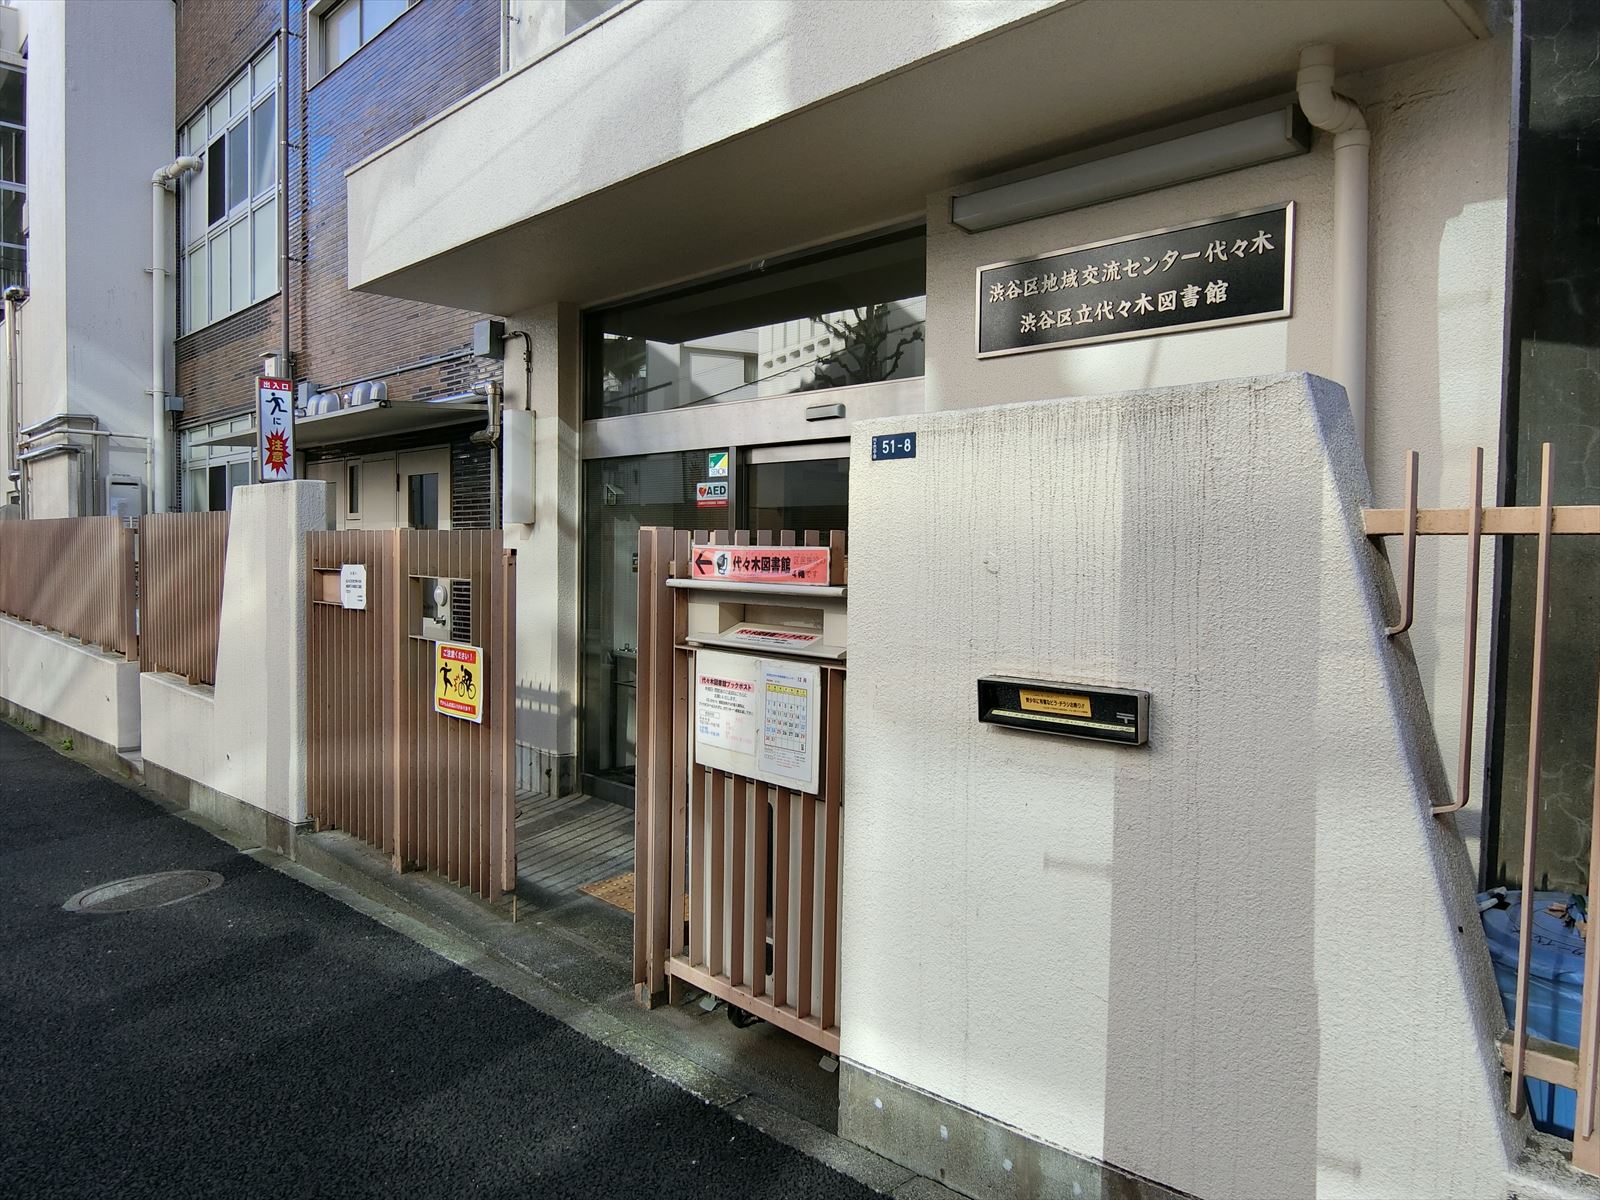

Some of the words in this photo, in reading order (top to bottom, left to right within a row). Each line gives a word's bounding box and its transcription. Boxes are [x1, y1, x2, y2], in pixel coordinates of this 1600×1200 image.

[989, 230, 1275, 303] 渋谷区地域交流センター代々木
[1020, 279, 1229, 334] 渋谷区立代々木図書館
[263, 381, 289, 390] 出入口
[273, 417, 281, 425] に
[272, 439, 283, 462] 注意
[882, 438, 911, 454] 51-8
[706, 485, 727, 496] AED
[732, 555, 791, 573] 代々木図書館
